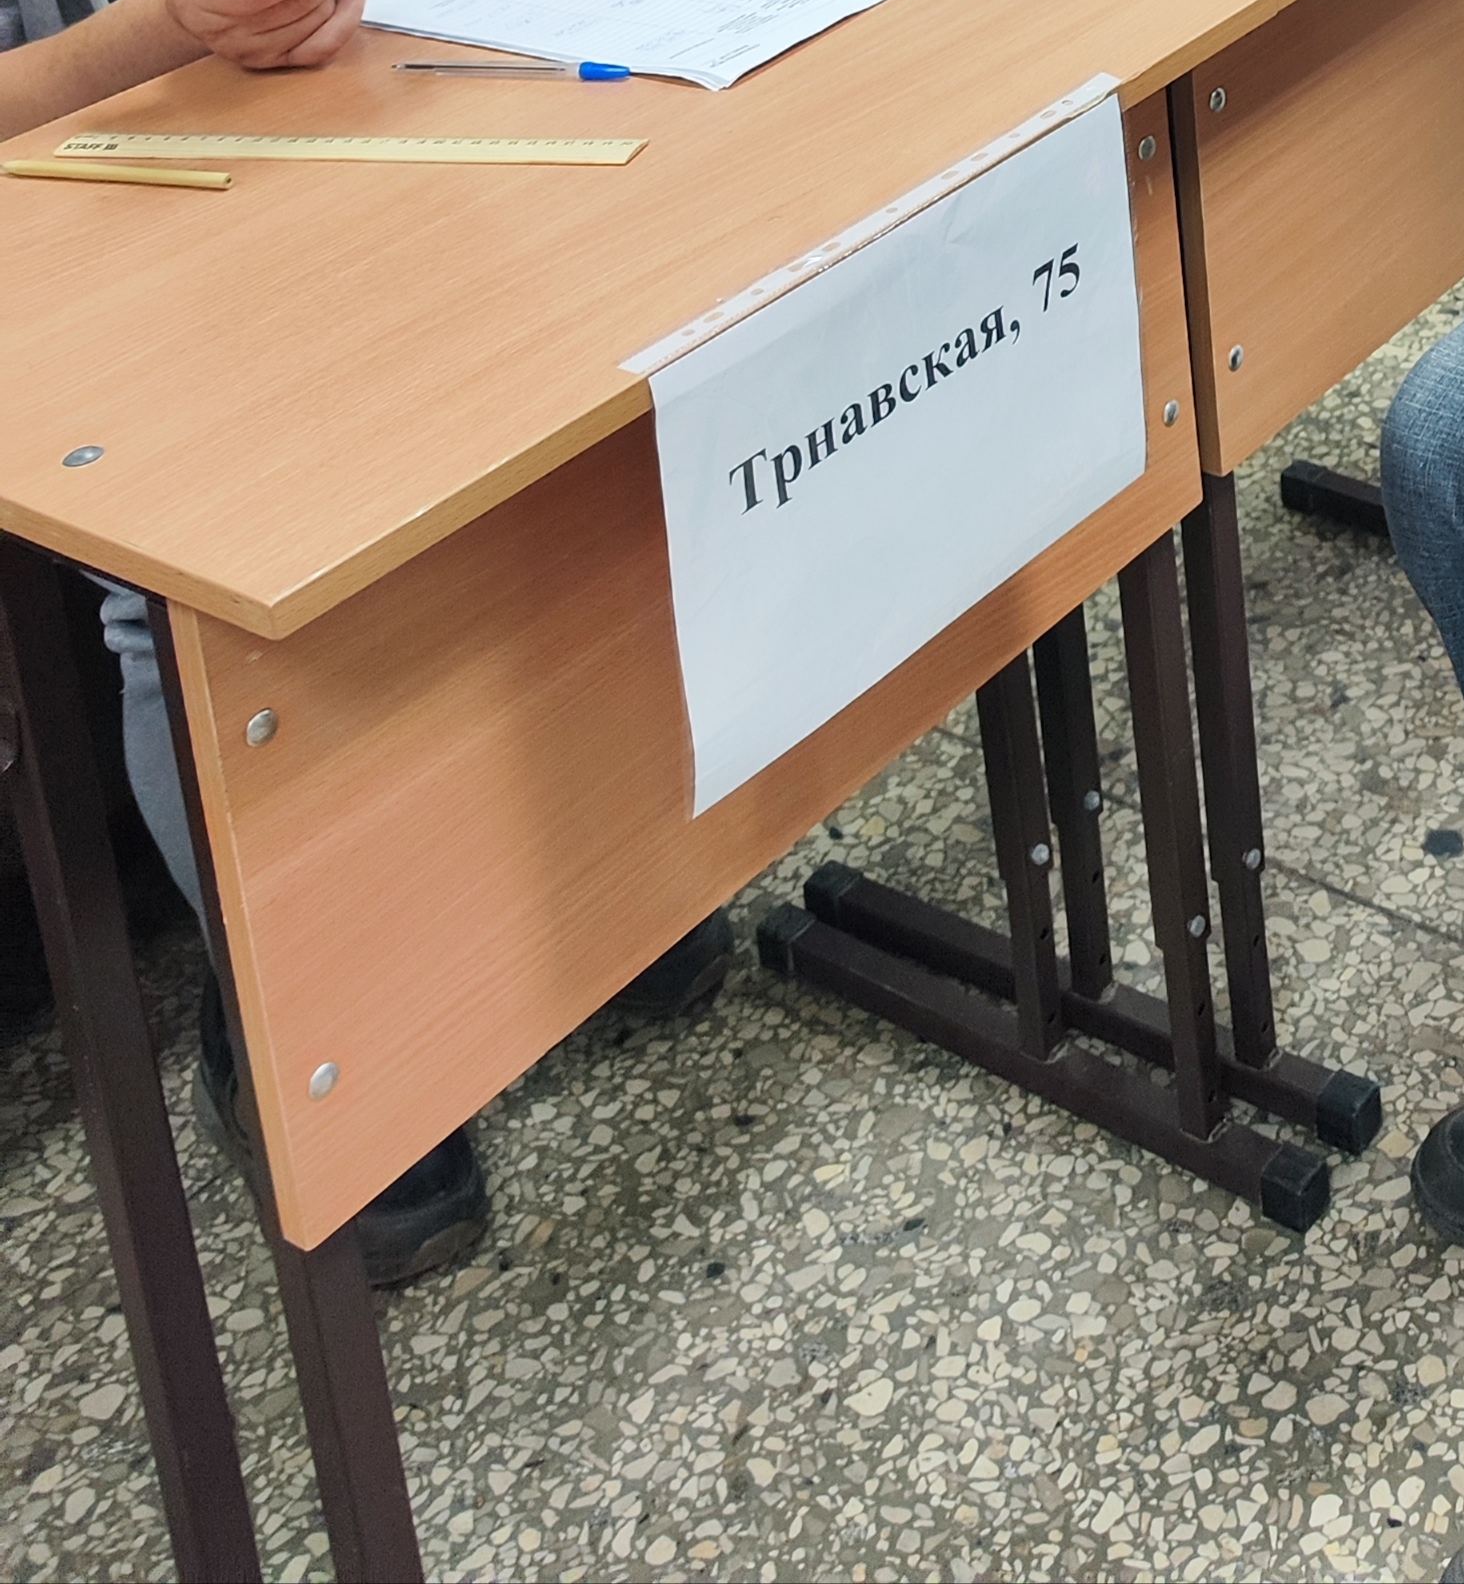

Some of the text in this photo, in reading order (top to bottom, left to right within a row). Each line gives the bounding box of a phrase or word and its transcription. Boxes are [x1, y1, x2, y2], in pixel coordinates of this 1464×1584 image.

[63, 142, 102, 151] STAFF
[728, 242, 1082, 516] Трнавская, 75
